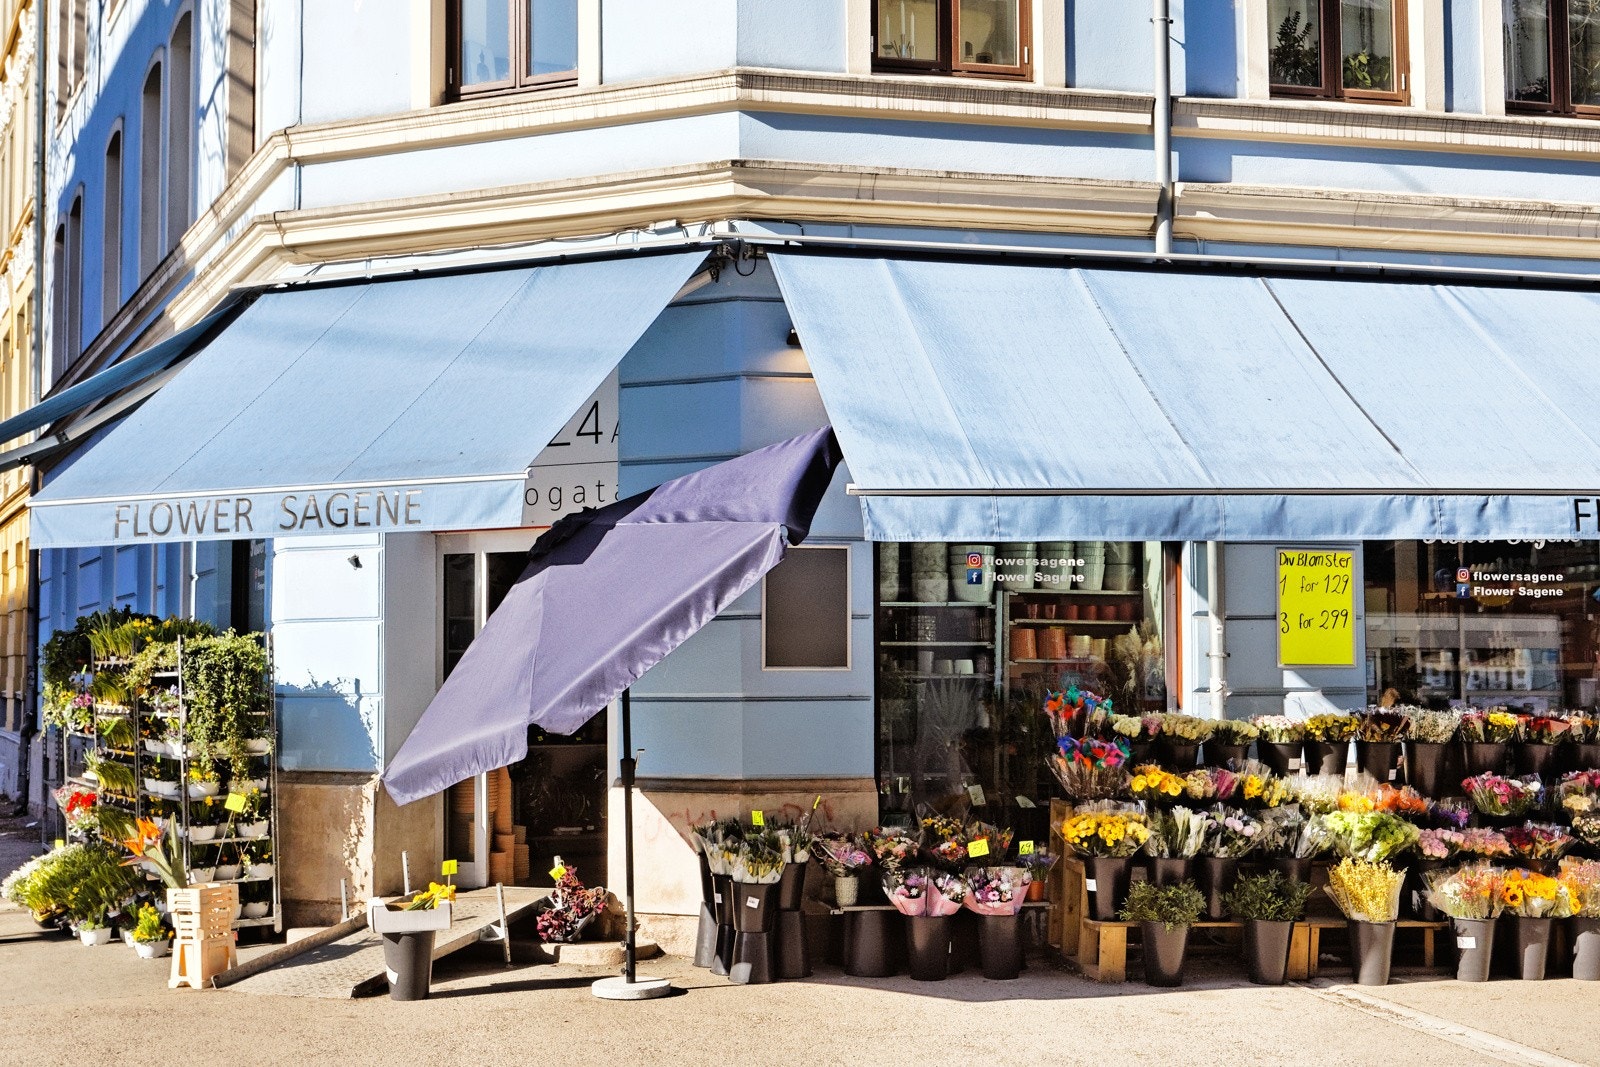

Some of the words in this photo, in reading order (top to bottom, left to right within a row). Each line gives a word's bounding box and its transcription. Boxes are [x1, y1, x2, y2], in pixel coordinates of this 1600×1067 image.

[114, 498, 253, 538] FLOWER
[279, 490, 423, 531] SAGENE
[1574, 498, 1600, 532] F
[984, 556, 1085, 568] flowersagene
[1279, 552, 1295, 566] Div
[984, 572, 1031, 582] Flower
[1034, 572, 1085, 584] Sagene
[1473, 572, 1564, 583] flowersagene
[1279, 574, 1287, 596] 1
[1300, 576, 1319, 593] for
[1324, 574, 1350, 595] 129
[1473, 587, 1514, 596] Flower
[1518, 587, 1564, 598] Sagene
[1280, 612, 1290, 634] 3
[1299, 613, 1314, 629] for
[1319, 609, 1349, 630] 299
